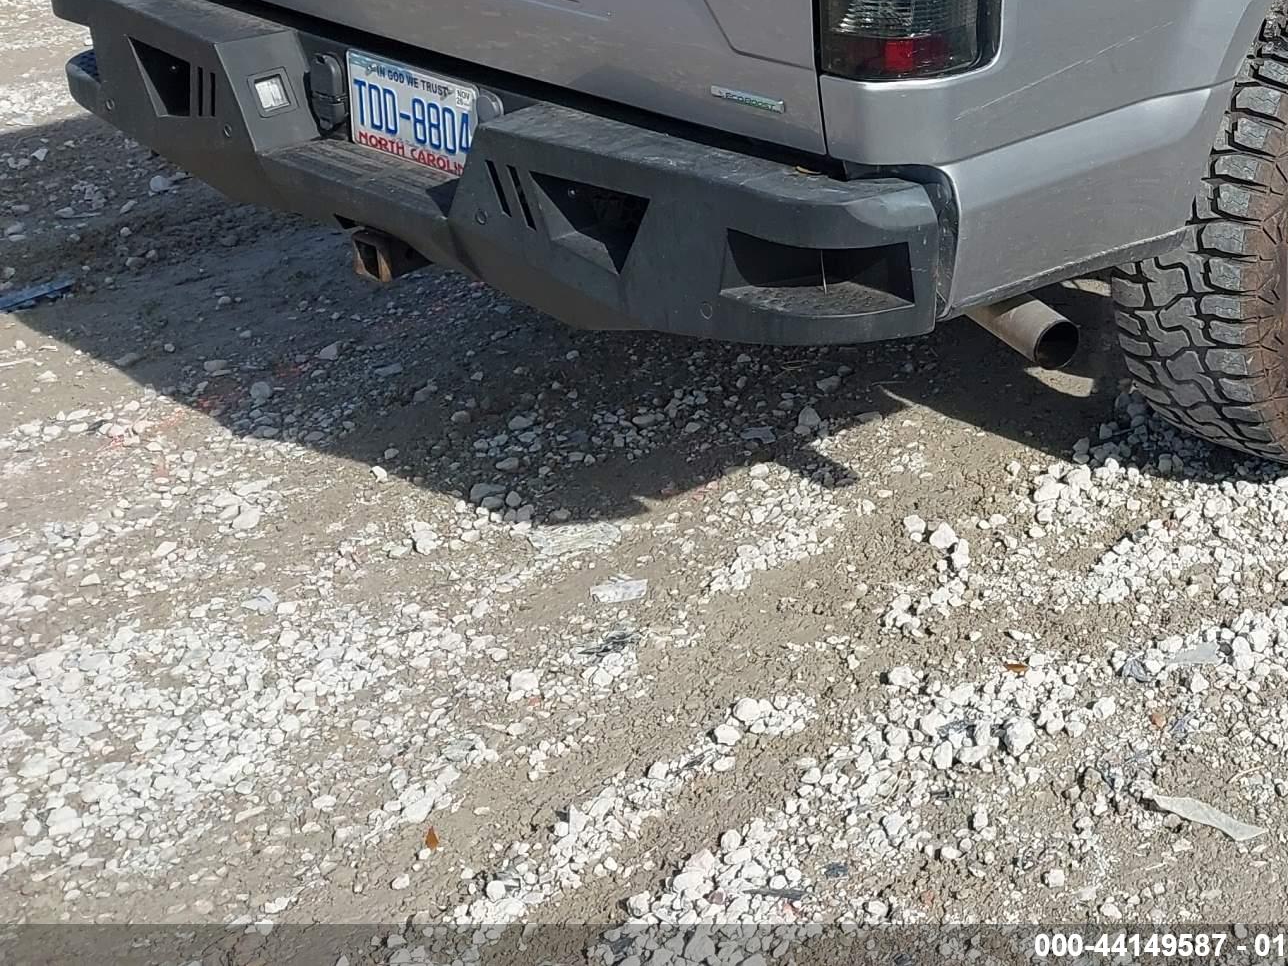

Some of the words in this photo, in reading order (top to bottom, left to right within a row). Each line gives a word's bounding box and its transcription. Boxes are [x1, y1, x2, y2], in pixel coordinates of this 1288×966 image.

[376, 65, 385, 78] IN
[388, 69, 404, 84] GOD
[406, 74, 418, 89] WE
[420, 79, 449, 96] TRUST
[353, 78, 471, 154] TDD-8804
[358, 131, 404, 157] NORTH
[410, 148, 464, 175] CAROLIN
